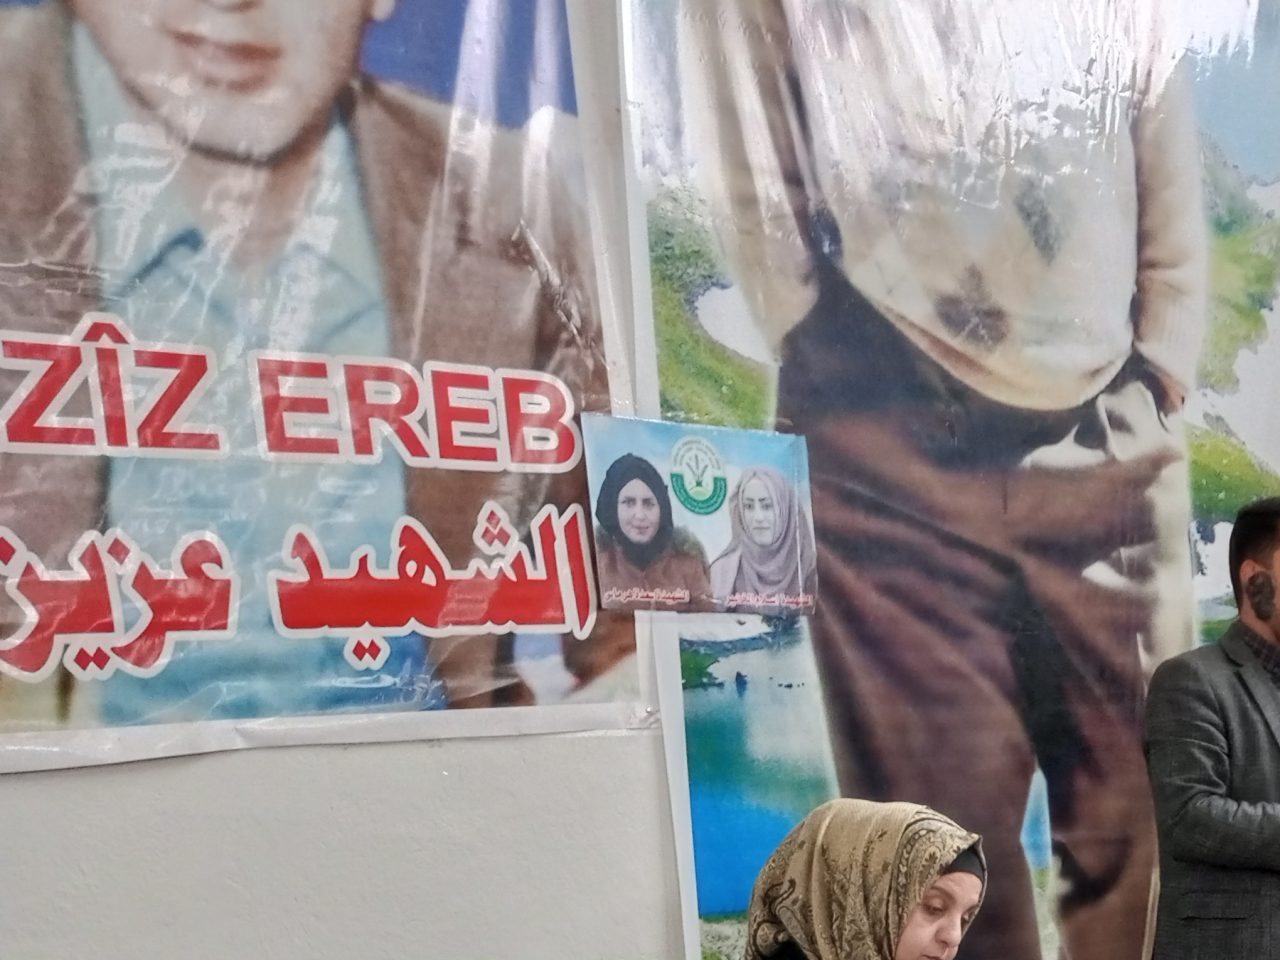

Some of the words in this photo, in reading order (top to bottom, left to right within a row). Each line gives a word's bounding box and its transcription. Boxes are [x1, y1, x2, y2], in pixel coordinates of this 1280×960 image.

[1, 322, 221, 451] ZÎZ
[257, 357, 577, 466] EREB
[0, 530, 238, 680] عزيز
[272, 505, 597, 668] الشهيد
